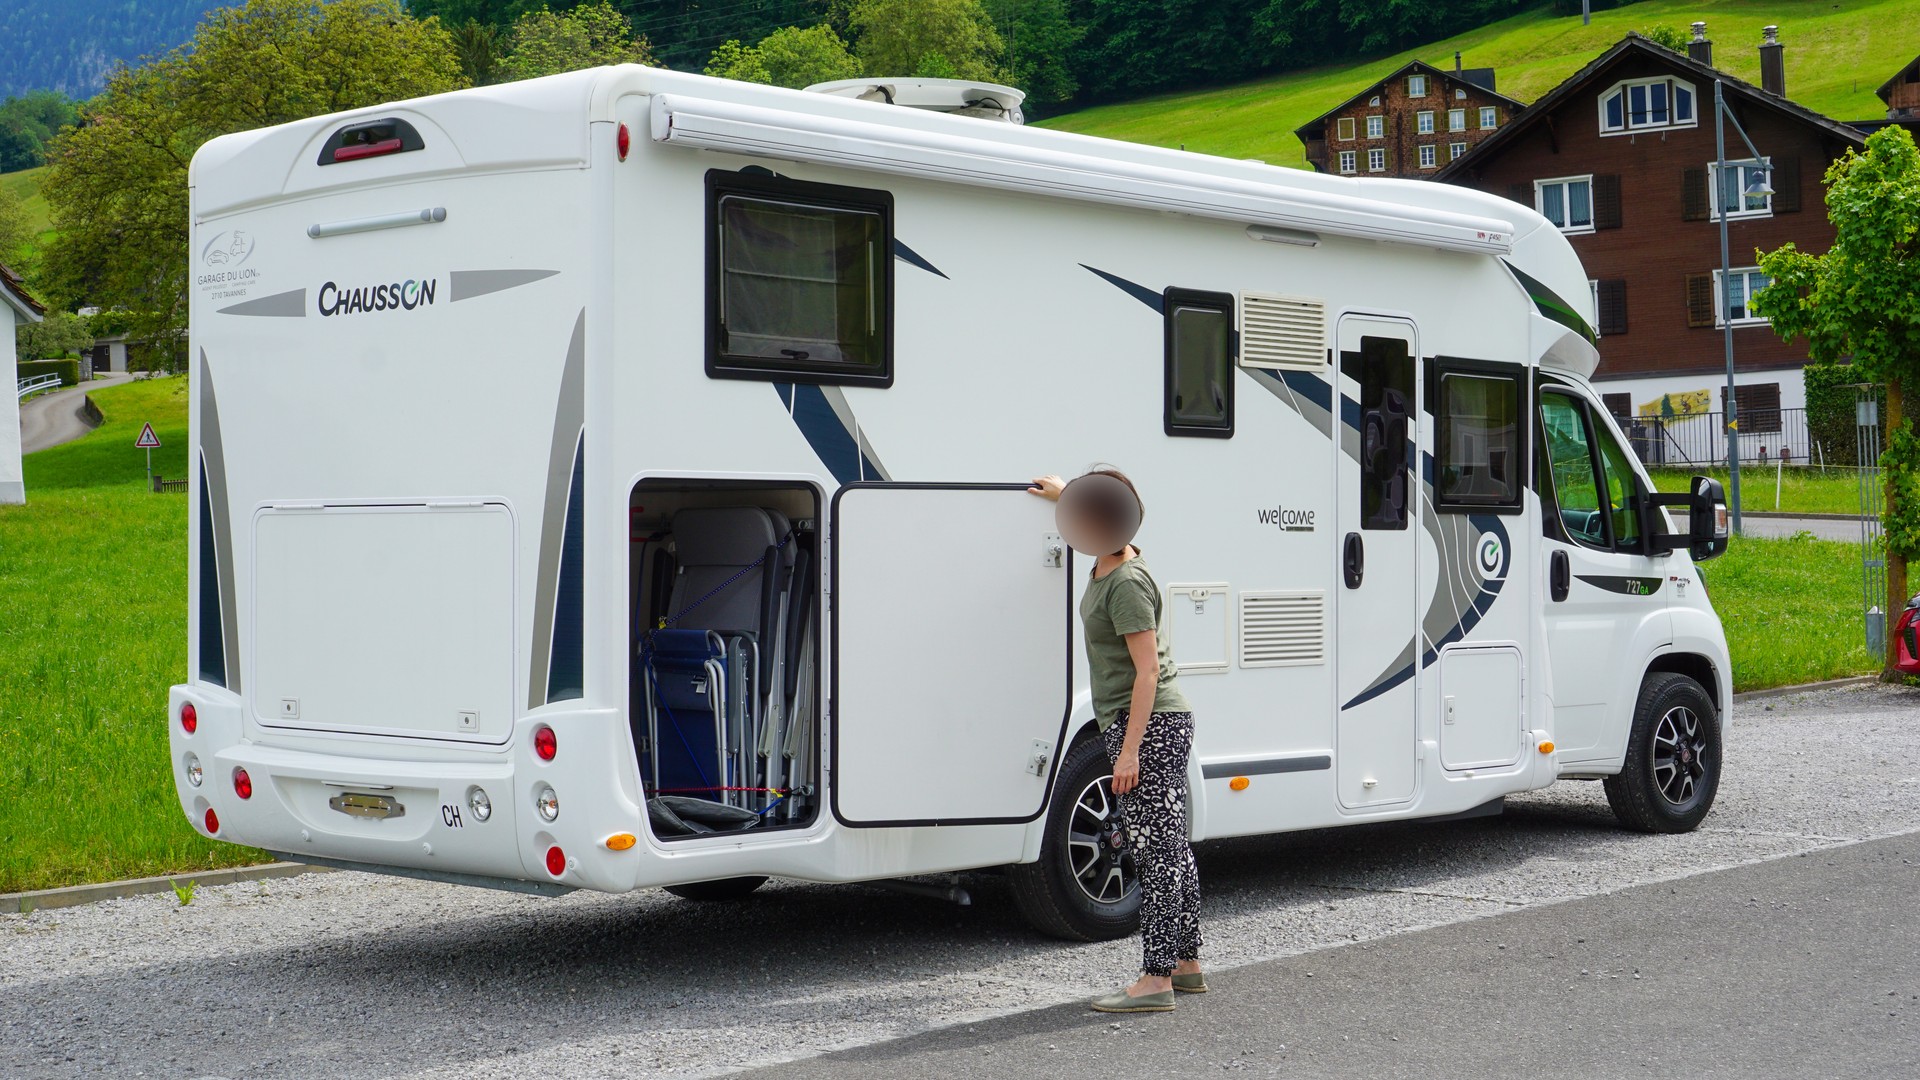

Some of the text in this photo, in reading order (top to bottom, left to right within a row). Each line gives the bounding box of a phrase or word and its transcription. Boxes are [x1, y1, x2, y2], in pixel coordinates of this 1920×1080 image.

[197, 273, 226, 285] GARAGE
[227, 271, 237, 281] DU
[239, 268, 256, 280] LION
[223, 288, 247, 298] TAVANNES
[318, 278, 437, 317] CHAUSSON
[1257, 504, 1315, 531] welcome
[441, 804, 463, 828] CH
